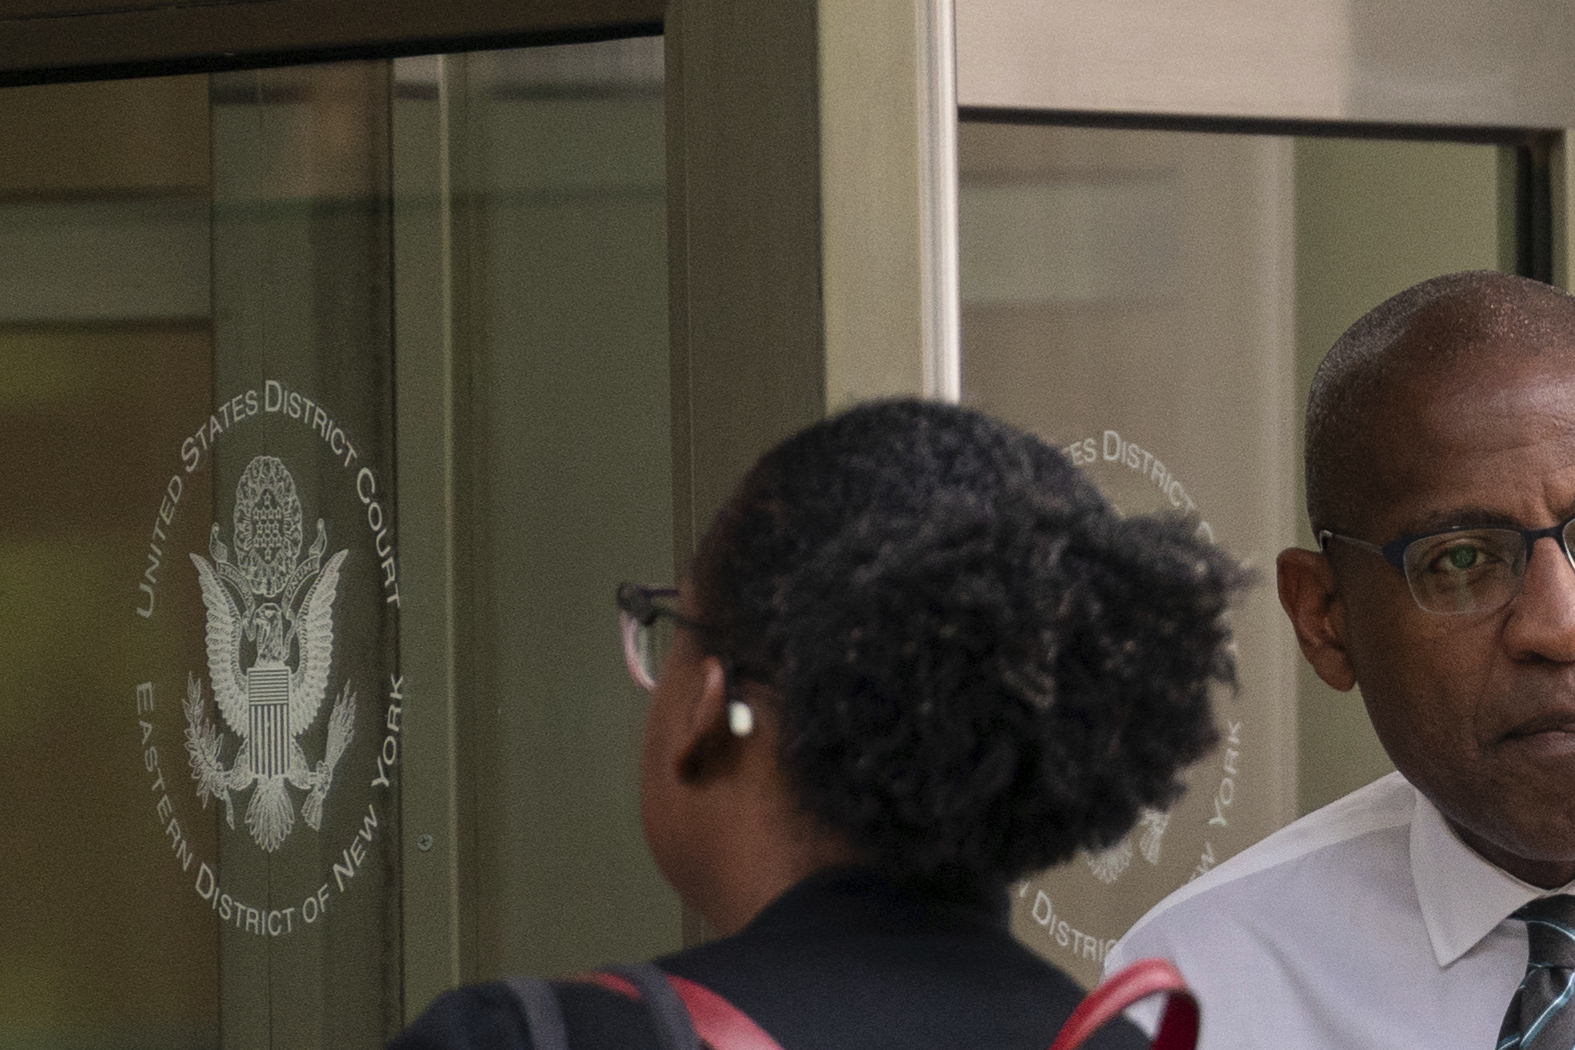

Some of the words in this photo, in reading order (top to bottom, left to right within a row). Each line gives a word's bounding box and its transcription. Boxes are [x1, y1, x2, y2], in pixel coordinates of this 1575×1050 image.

[136, 475, 183, 619] UNITED
[181, 390, 259, 473] STATES
[265, 380, 358, 468] DISTRICT
[356, 467, 401, 609] COURT
[135, 681, 193, 872] EASTERN
[195, 862, 295, 936] DISTRICT
[302, 883, 330, 924] OF
[332, 804, 378, 893] NEW
[371, 673, 404, 788] YORK
[1032, 889, 1118, 962] DISTRI
